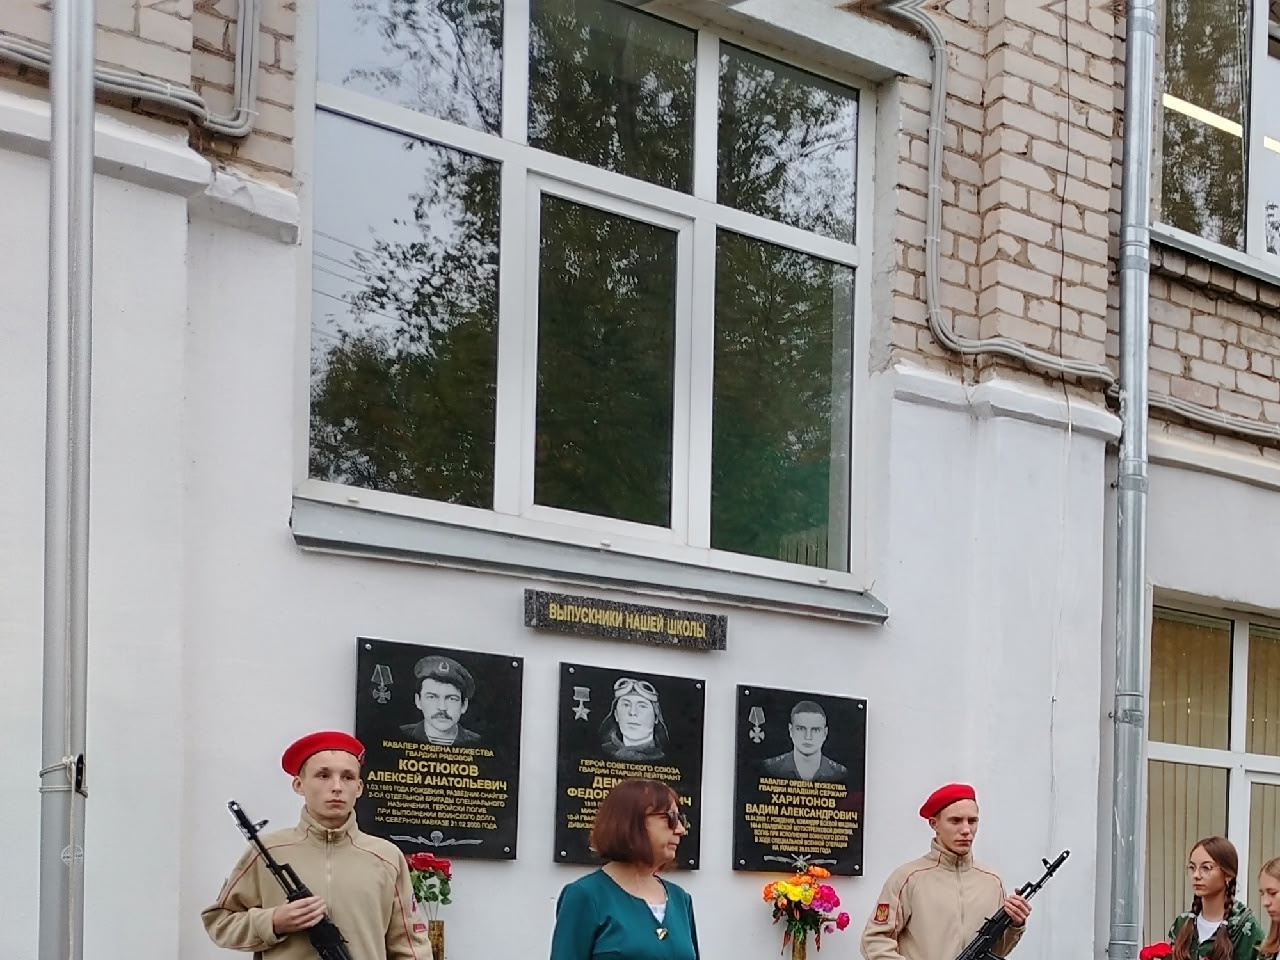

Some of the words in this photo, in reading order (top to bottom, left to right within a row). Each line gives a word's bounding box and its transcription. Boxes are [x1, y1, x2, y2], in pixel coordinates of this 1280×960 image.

[549, 603, 623, 628] ВЫПУСКНИКИ
[626, 614, 664, 632] НАШЕЙ
[667, 619, 705, 638] ШКОЛЫ
[383, 740, 418, 749] КАВАЛЕР
[420, 744, 451, 753] ОРДЕНА
[452, 747, 494, 757] МУЖЕСТВА
[439, 753, 474, 762] РЯДОВОЙ
[398, 759, 479, 776] КОСТЮКОВ
[579, 766, 609, 775] ГВАРДИИ
[610, 769, 642, 777] СТАРШИЙ
[644, 772, 681, 781] ЛЕЙТЕНАНТ
[607, 762, 653, 771] СОВЕТСКОГО
[654, 766, 680, 774] СОЮЗА
[368, 770, 422, 783] АЛЕКСЕЙ
[424, 775, 507, 790] АНАТОЛЬЕВИЧ
[771, 794, 836, 808] ХАРИТОНОВ
[745, 803, 778, 815] ВАДИМ
[780, 806, 858, 820] АЛЕКСАНДРОВИЧ
